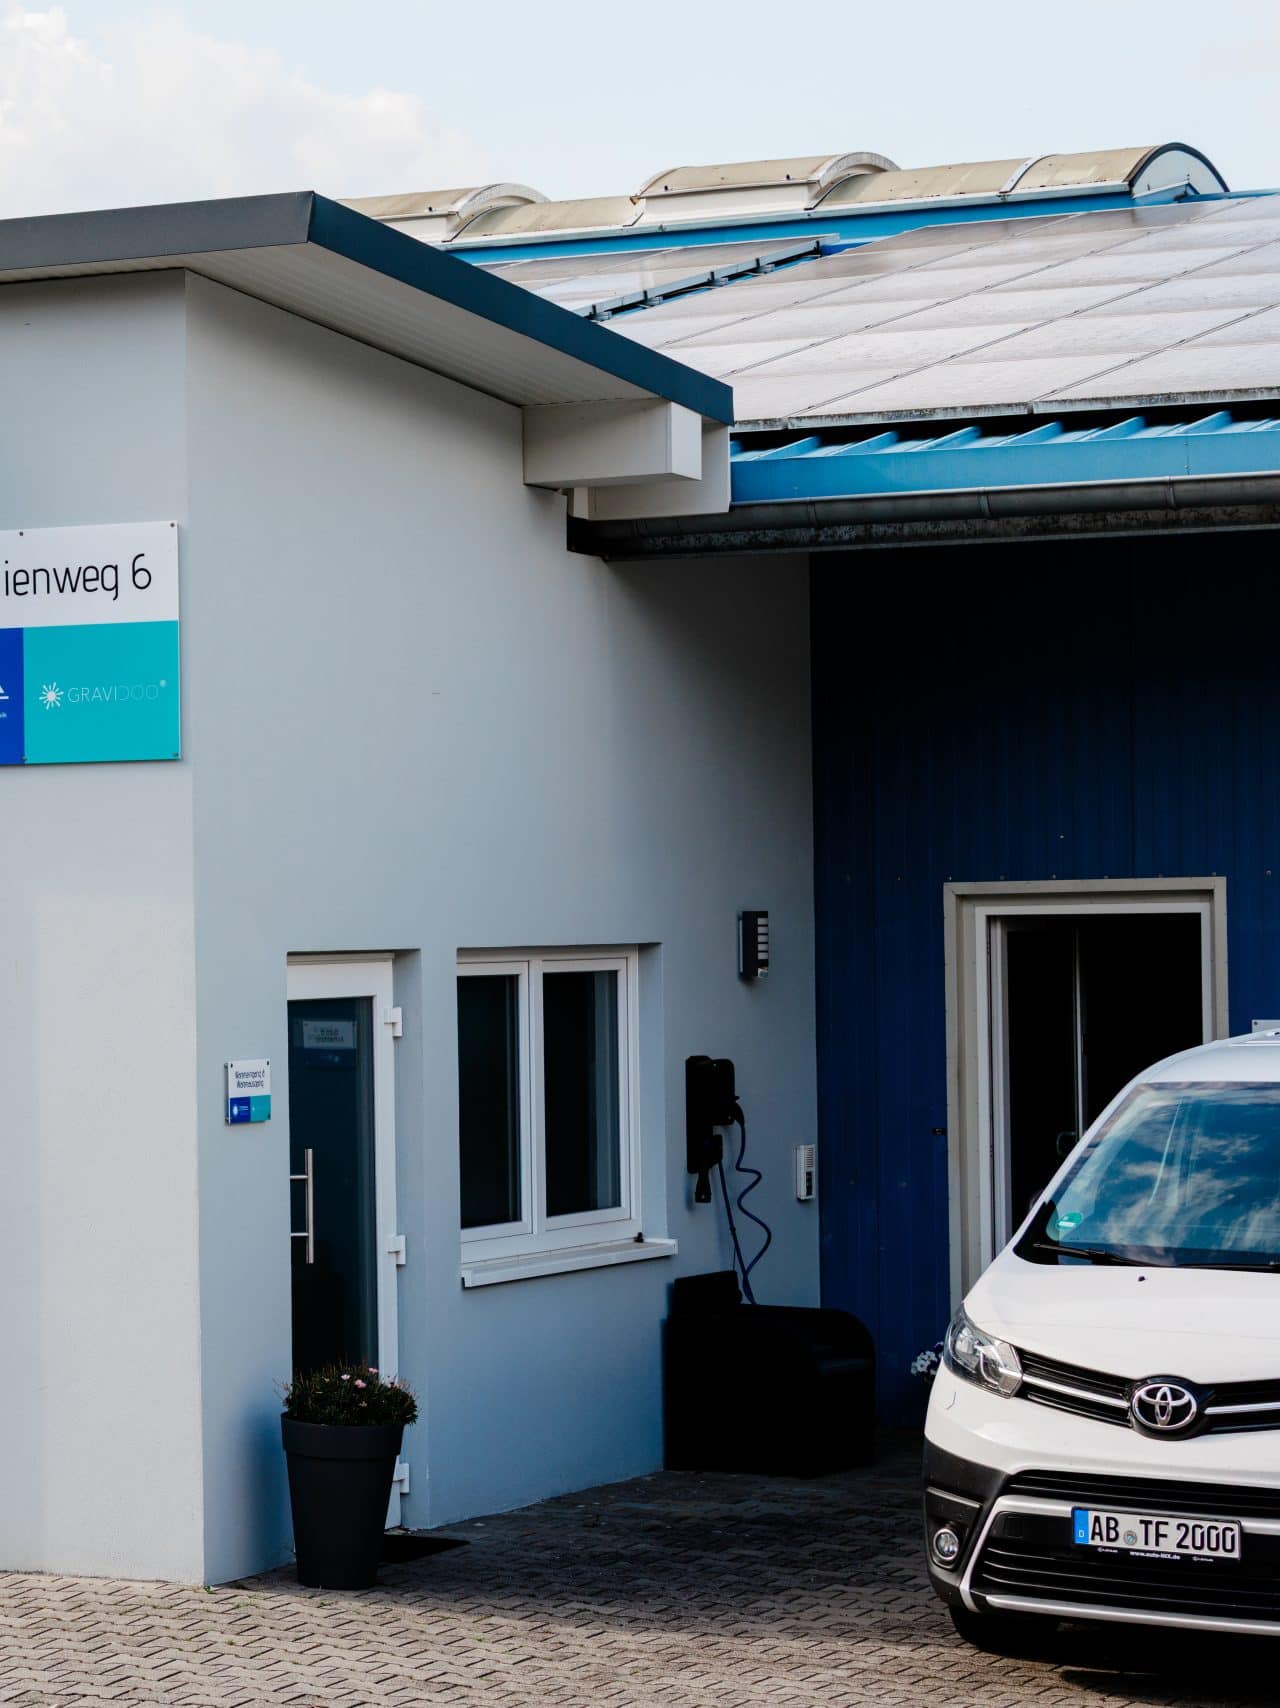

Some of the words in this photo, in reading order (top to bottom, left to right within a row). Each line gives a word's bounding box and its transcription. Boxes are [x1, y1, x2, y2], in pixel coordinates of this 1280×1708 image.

[131, 553, 152, 590] 6
[1091, 1515, 1119, 1543] AB
[1139, 1519, 1169, 1547] TF
[1176, 1523, 1235, 1553] 2000
